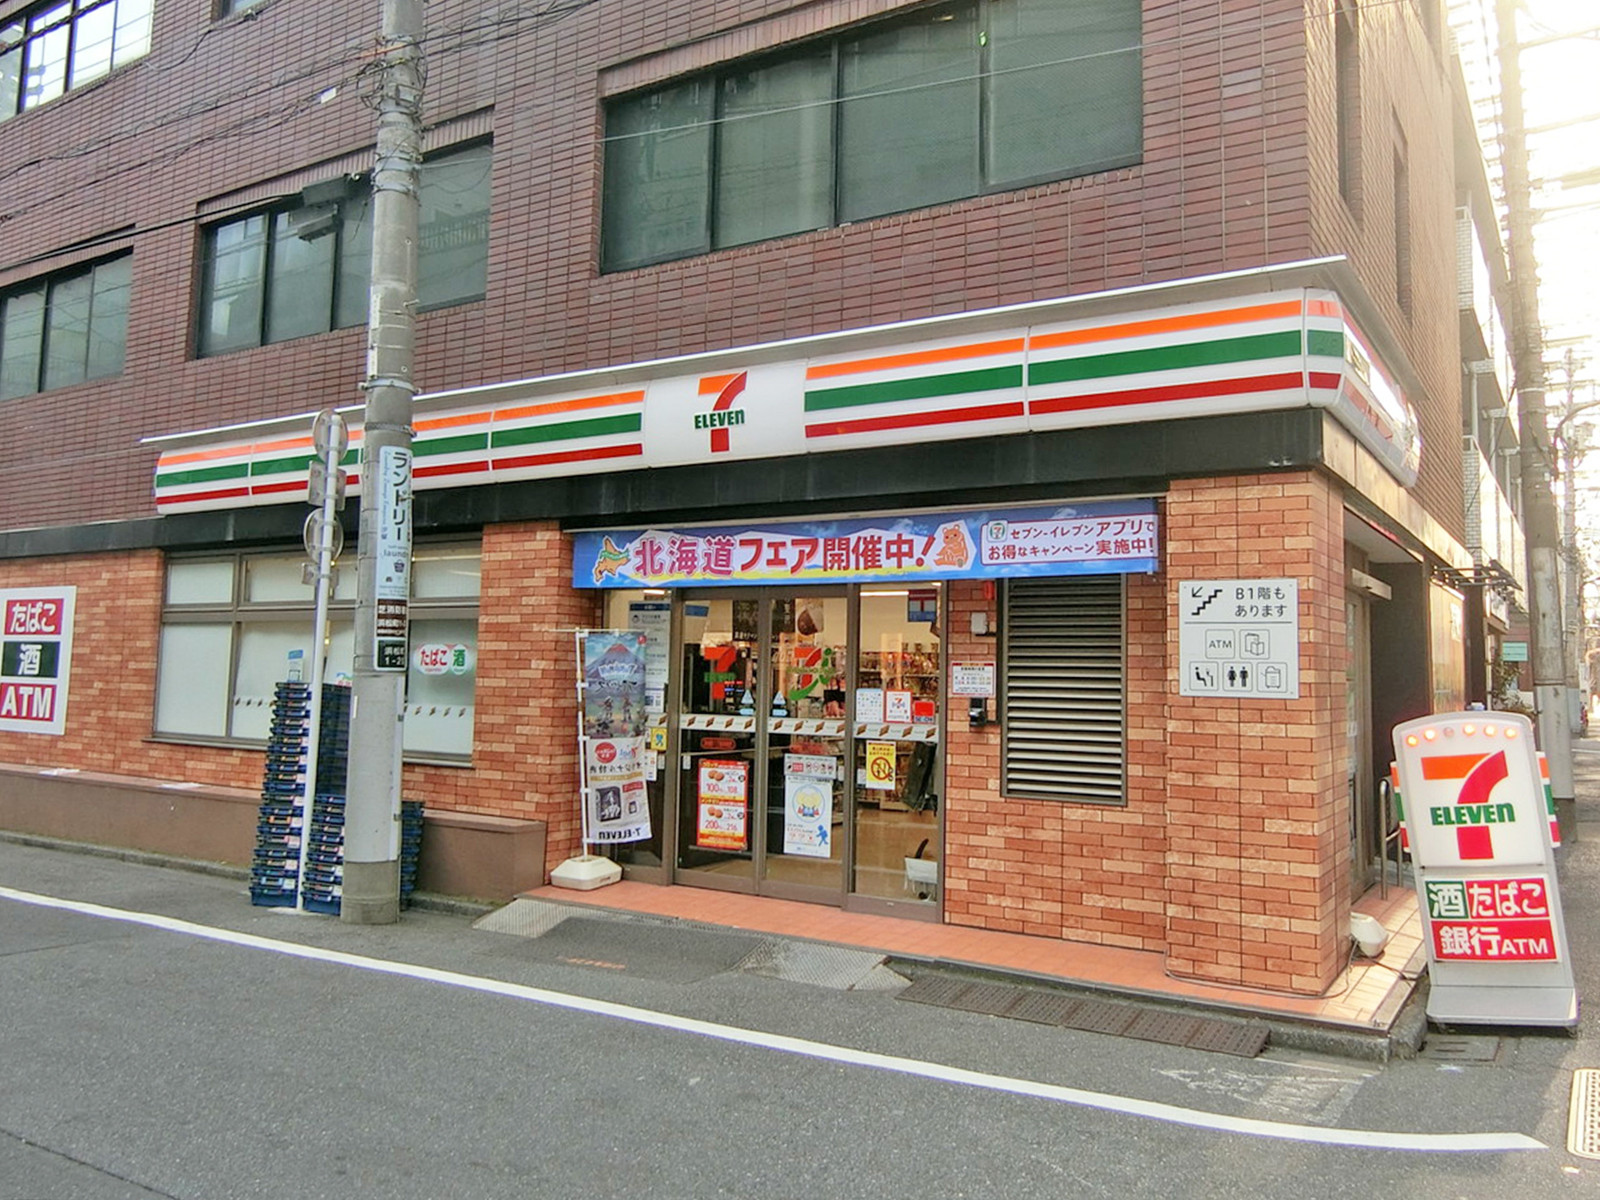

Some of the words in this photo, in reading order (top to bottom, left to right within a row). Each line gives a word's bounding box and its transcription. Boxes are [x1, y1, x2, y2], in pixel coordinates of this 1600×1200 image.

[698, 370, 748, 453] 7
[634, 535, 936, 577] 北海道フェア開催中!
[988, 538, 1154, 561] お得なキャンペーン実施中!
[1235, 587, 1285, 600] B1階も
[10, 602, 57, 633] たばこ
[1235, 604, 1287, 617] あります
[18, 644, 42, 675] 酒
[420, 649, 447, 667] たばこ
[453, 649, 466, 667] 酒
[1209, 640, 1232, 648] ATM
[1, 686, 52, 719] ATM
[1421, 750, 1509, 860] 7
[1428, 883, 1461, 918] 酒
[1468, 883, 1546, 918] たばこ
